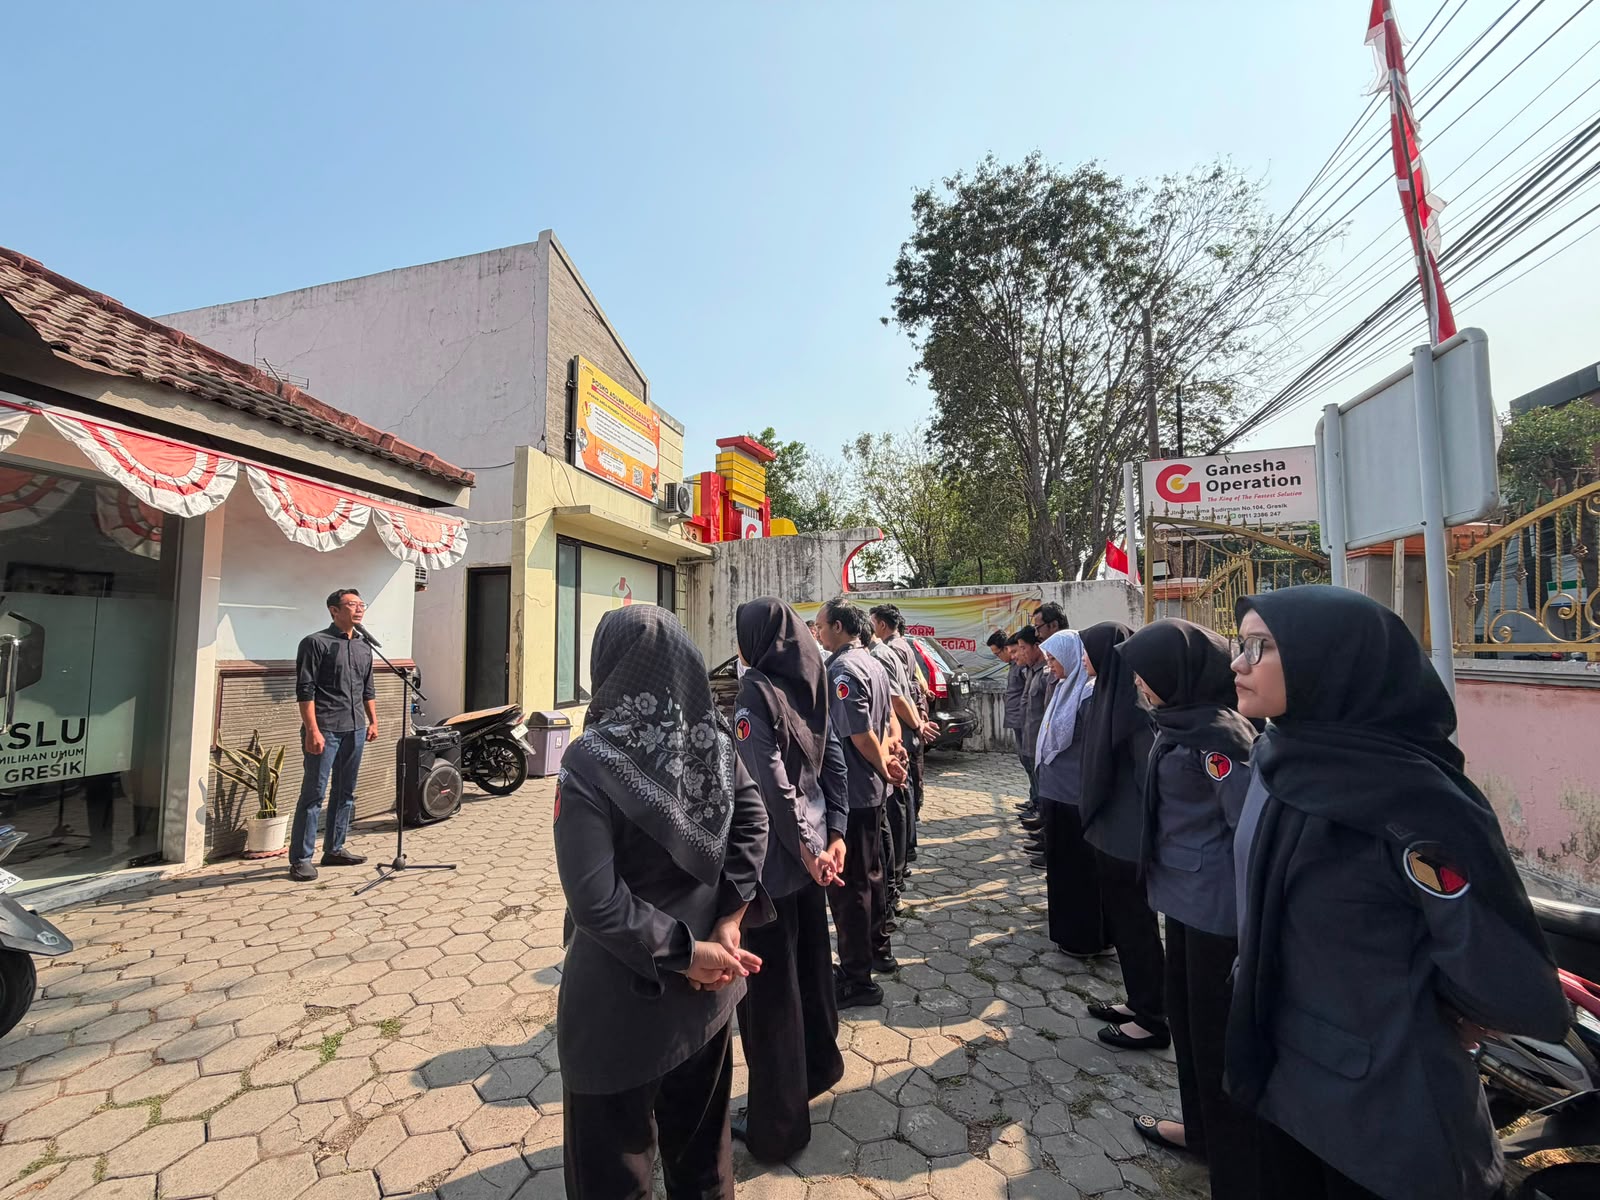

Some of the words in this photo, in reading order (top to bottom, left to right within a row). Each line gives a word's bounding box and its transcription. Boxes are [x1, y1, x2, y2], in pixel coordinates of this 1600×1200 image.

[1205, 459, 1286, 477] Ganesha
[1205, 474, 1302, 494] Operation
[0, 717, 86, 751] SLU
[50, 748, 84, 759] UMUM
[4, 760, 82, 784] GRESIK
